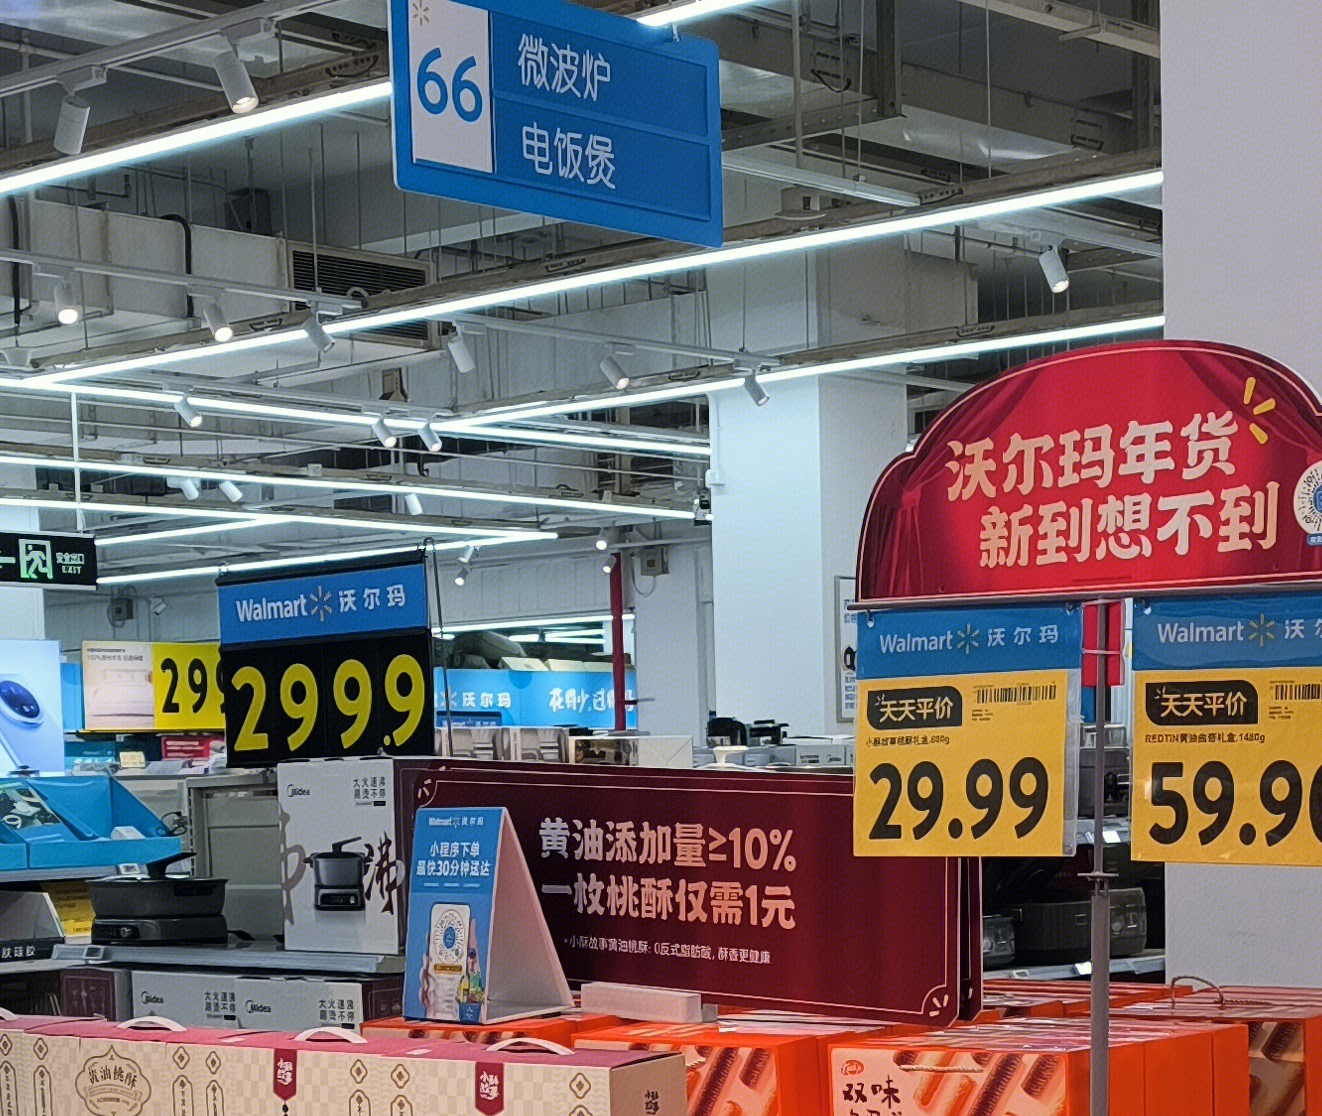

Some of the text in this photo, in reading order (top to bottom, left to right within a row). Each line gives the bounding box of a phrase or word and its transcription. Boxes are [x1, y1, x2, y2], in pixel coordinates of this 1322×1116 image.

[417, 47, 482, 122] 66
[518, 33, 611, 101] 微波炉
[522, 121, 615, 189] 电饭煲
[945, 410, 1238, 502] 沃尔玛年货
[979, 480, 1280, 570] 新到想不到
[235, 584, 405, 622] Walmart 沃尔玛
[879, 624, 1059, 654] Walmart 沃尔玛
[1157, 621, 1244, 643] Walmart
[231, 654, 425, 751] 299.9
[462, 692, 511, 709] 沃尔玛
[879, 696, 954, 723] 天天平价
[1160, 691, 1247, 718] 天天平价
[286, 784, 310, 797] Midea
[868, 756, 1049, 841] 29.99
[430, 841, 480, 858] 小程序下单
[539, 817, 796, 871] 黄油添加量≥10%
[416, 860, 490, 877] 最快30分钟送达
[541, 873, 796, 930] 一枚桃酥仅需1元
[141, 991, 163, 1004] Midea
[245, 1000, 271, 1014] Midea
[843, 1074, 901, 1109] 双味
